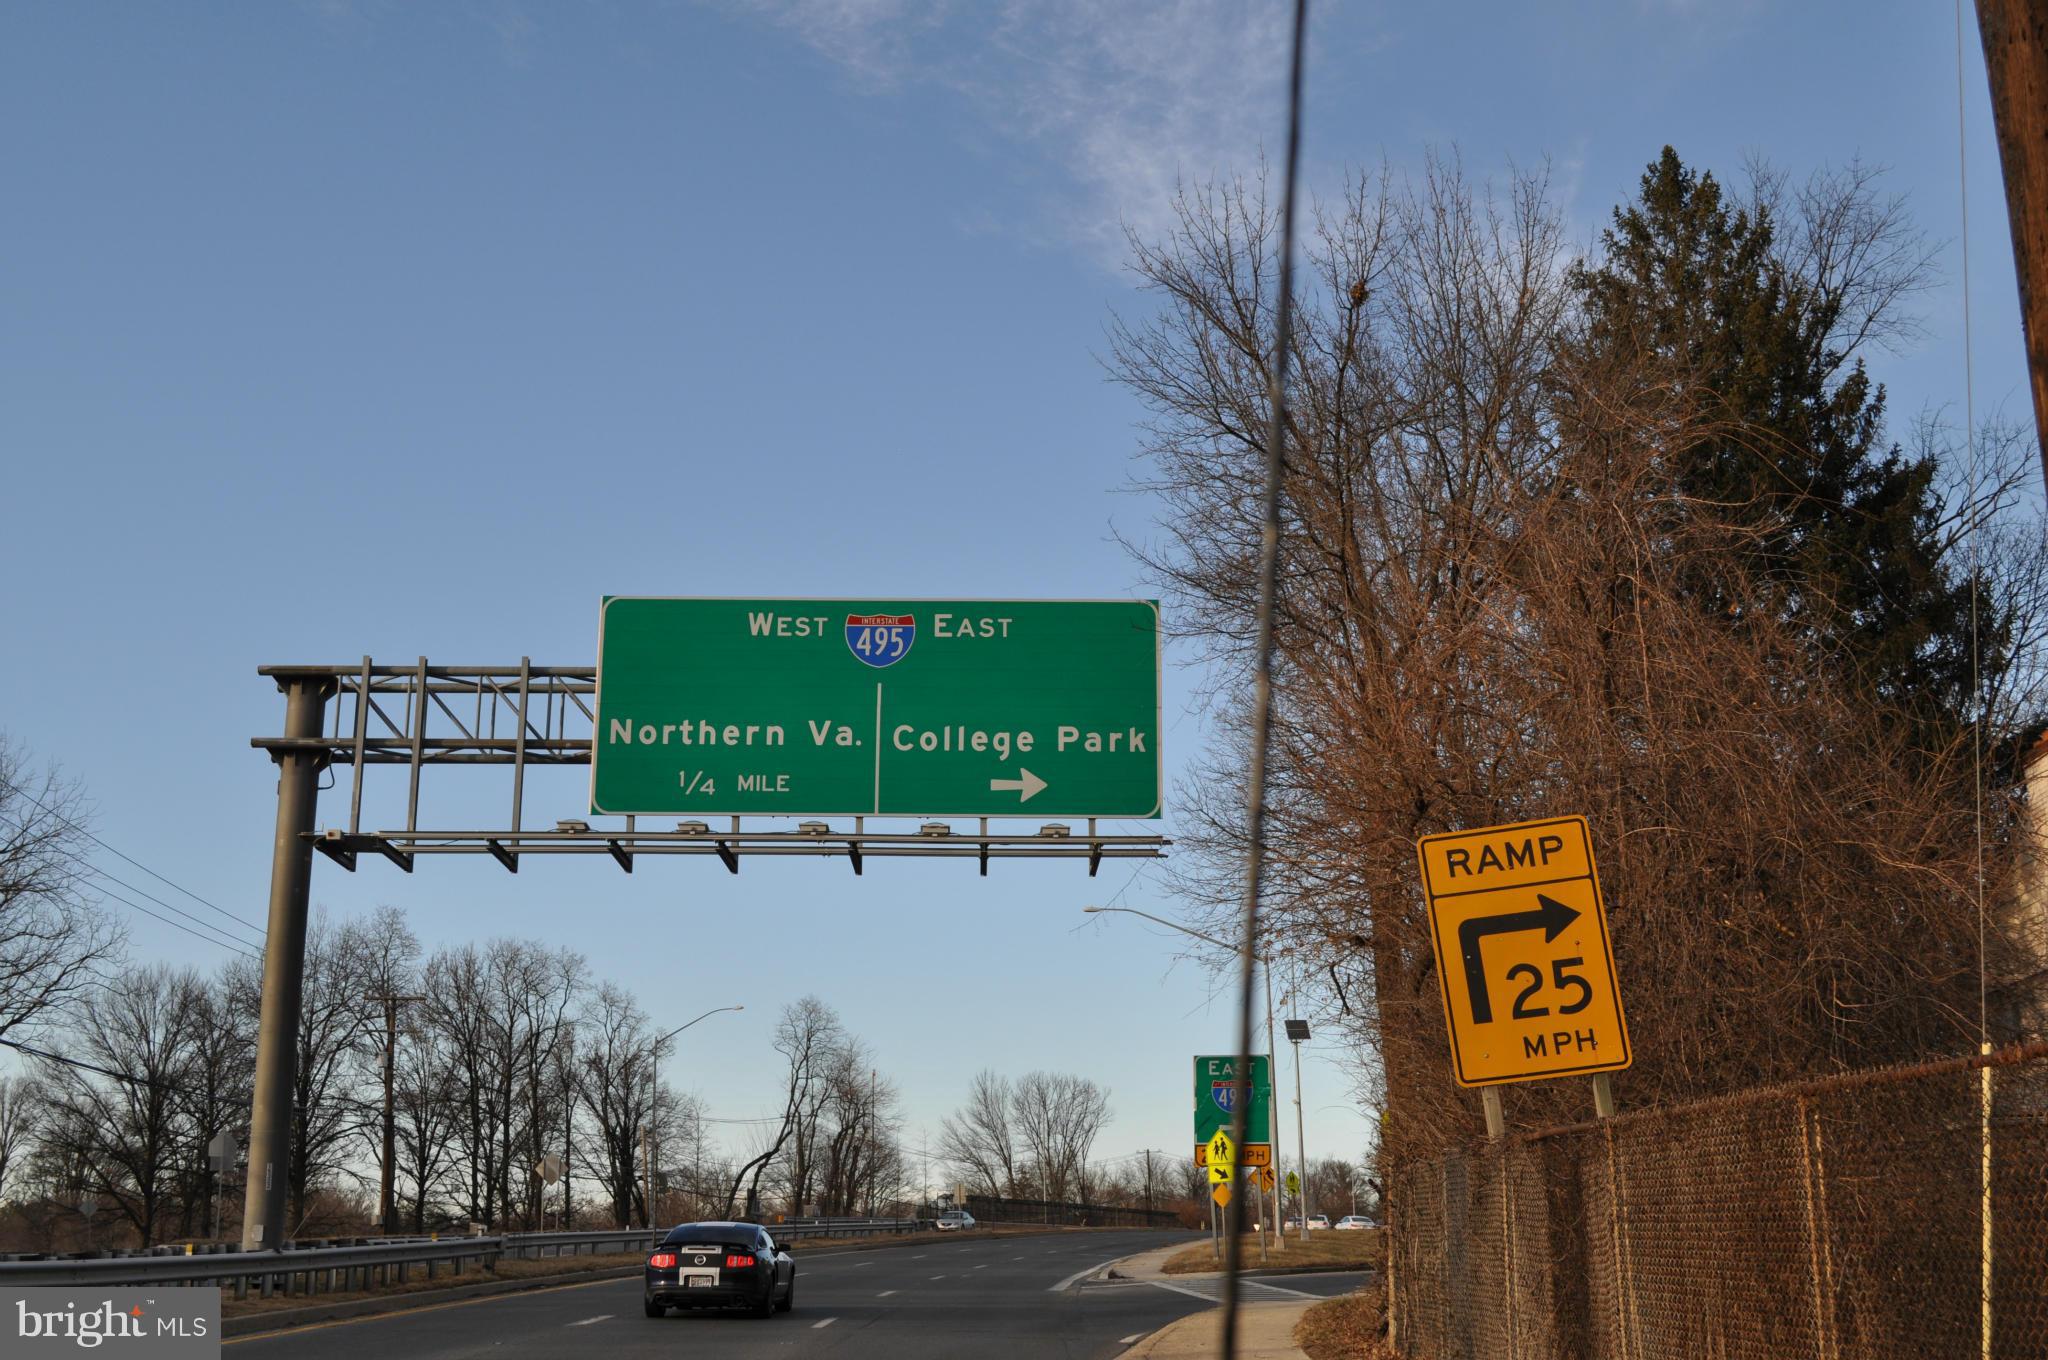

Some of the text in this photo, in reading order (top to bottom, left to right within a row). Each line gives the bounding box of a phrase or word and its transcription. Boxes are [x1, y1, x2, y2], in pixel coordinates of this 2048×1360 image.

[748, 612, 829, 637] WEST
[861, 617, 900, 625] INTERSTATE
[934, 613, 1013, 638] EAST
[856, 627, 904, 657] 495
[609, 718, 862, 746] Northern Va.
[892, 724, 1147, 761] College Park
[679, 770, 790, 796] 1/4 MILE
[1446, 835, 1564, 878] RAMP
[1505, 956, 1593, 1020] 25
[1522, 1028, 1599, 1059] MPH
